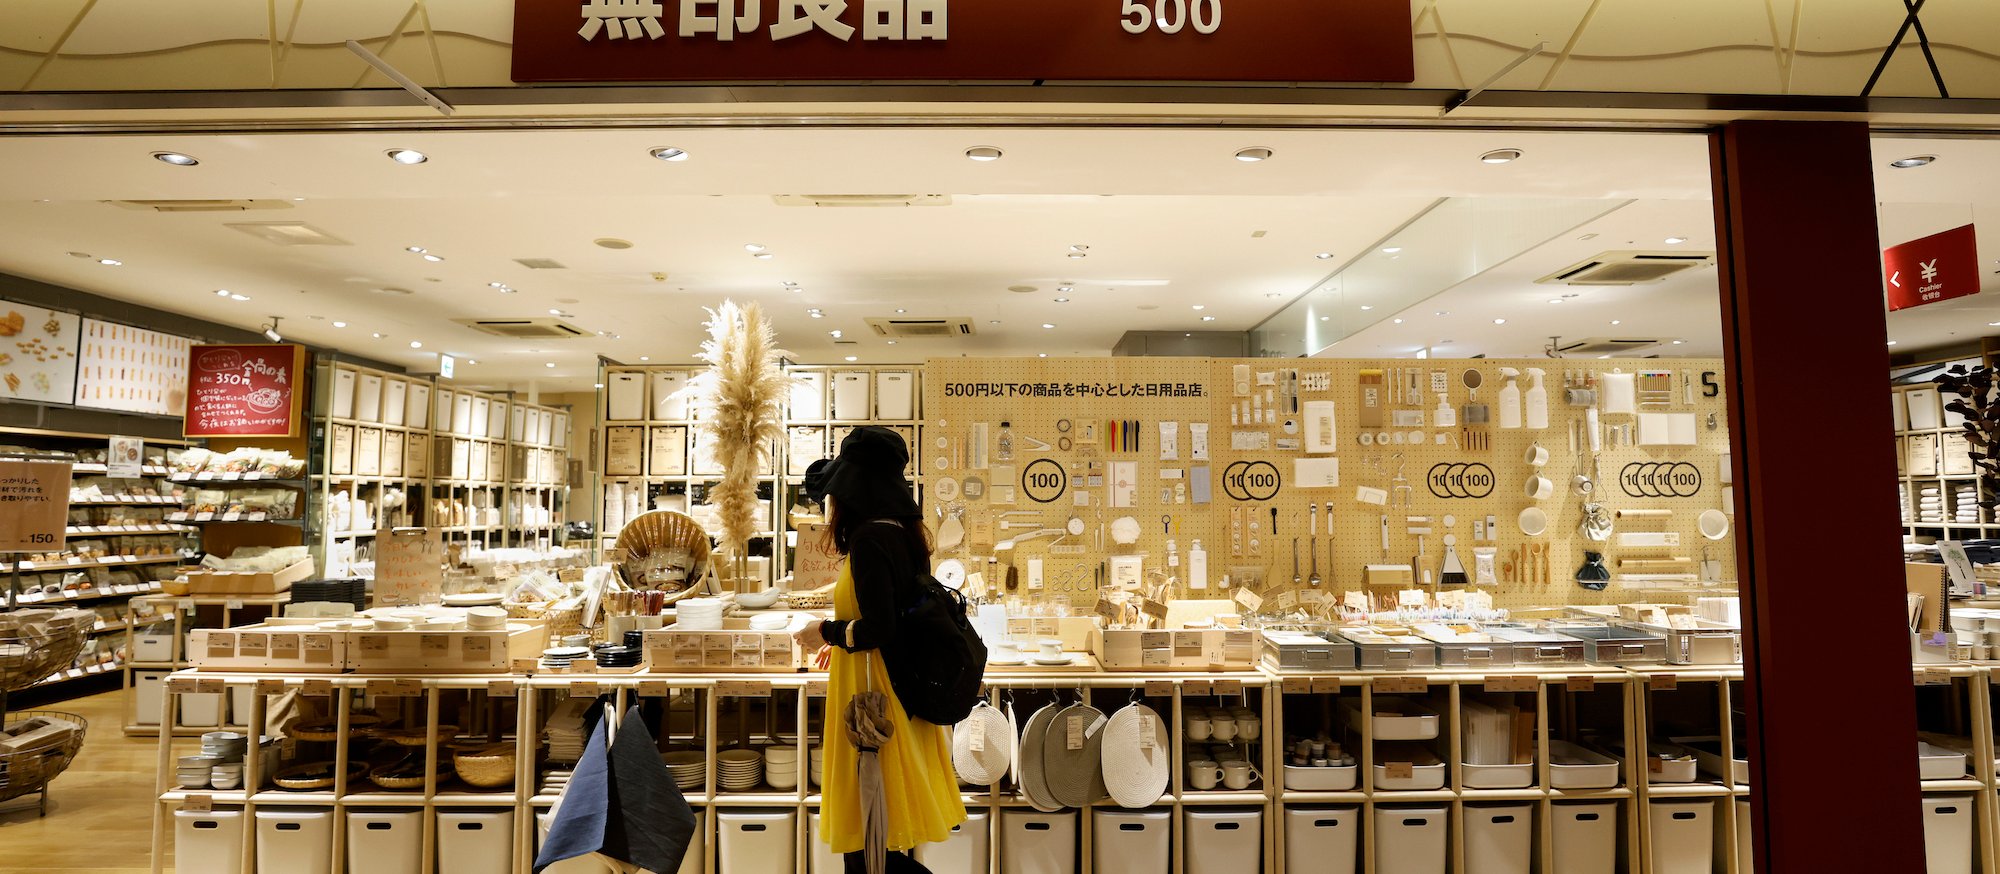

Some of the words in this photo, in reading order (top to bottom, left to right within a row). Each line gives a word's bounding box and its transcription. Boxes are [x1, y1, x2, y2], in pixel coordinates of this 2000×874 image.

[1120, 0, 1222, 34] 500
[1918, 283, 1942, 293] Cashier
[945, 383, 1209, 398] 500円以下の商品を中心とした日用品店。
[1029, 473, 1059, 488] 100
[1247, 474, 1274, 487] 100
[1465, 475, 1489, 486] 100
[1673, 474, 1696, 485] 100
